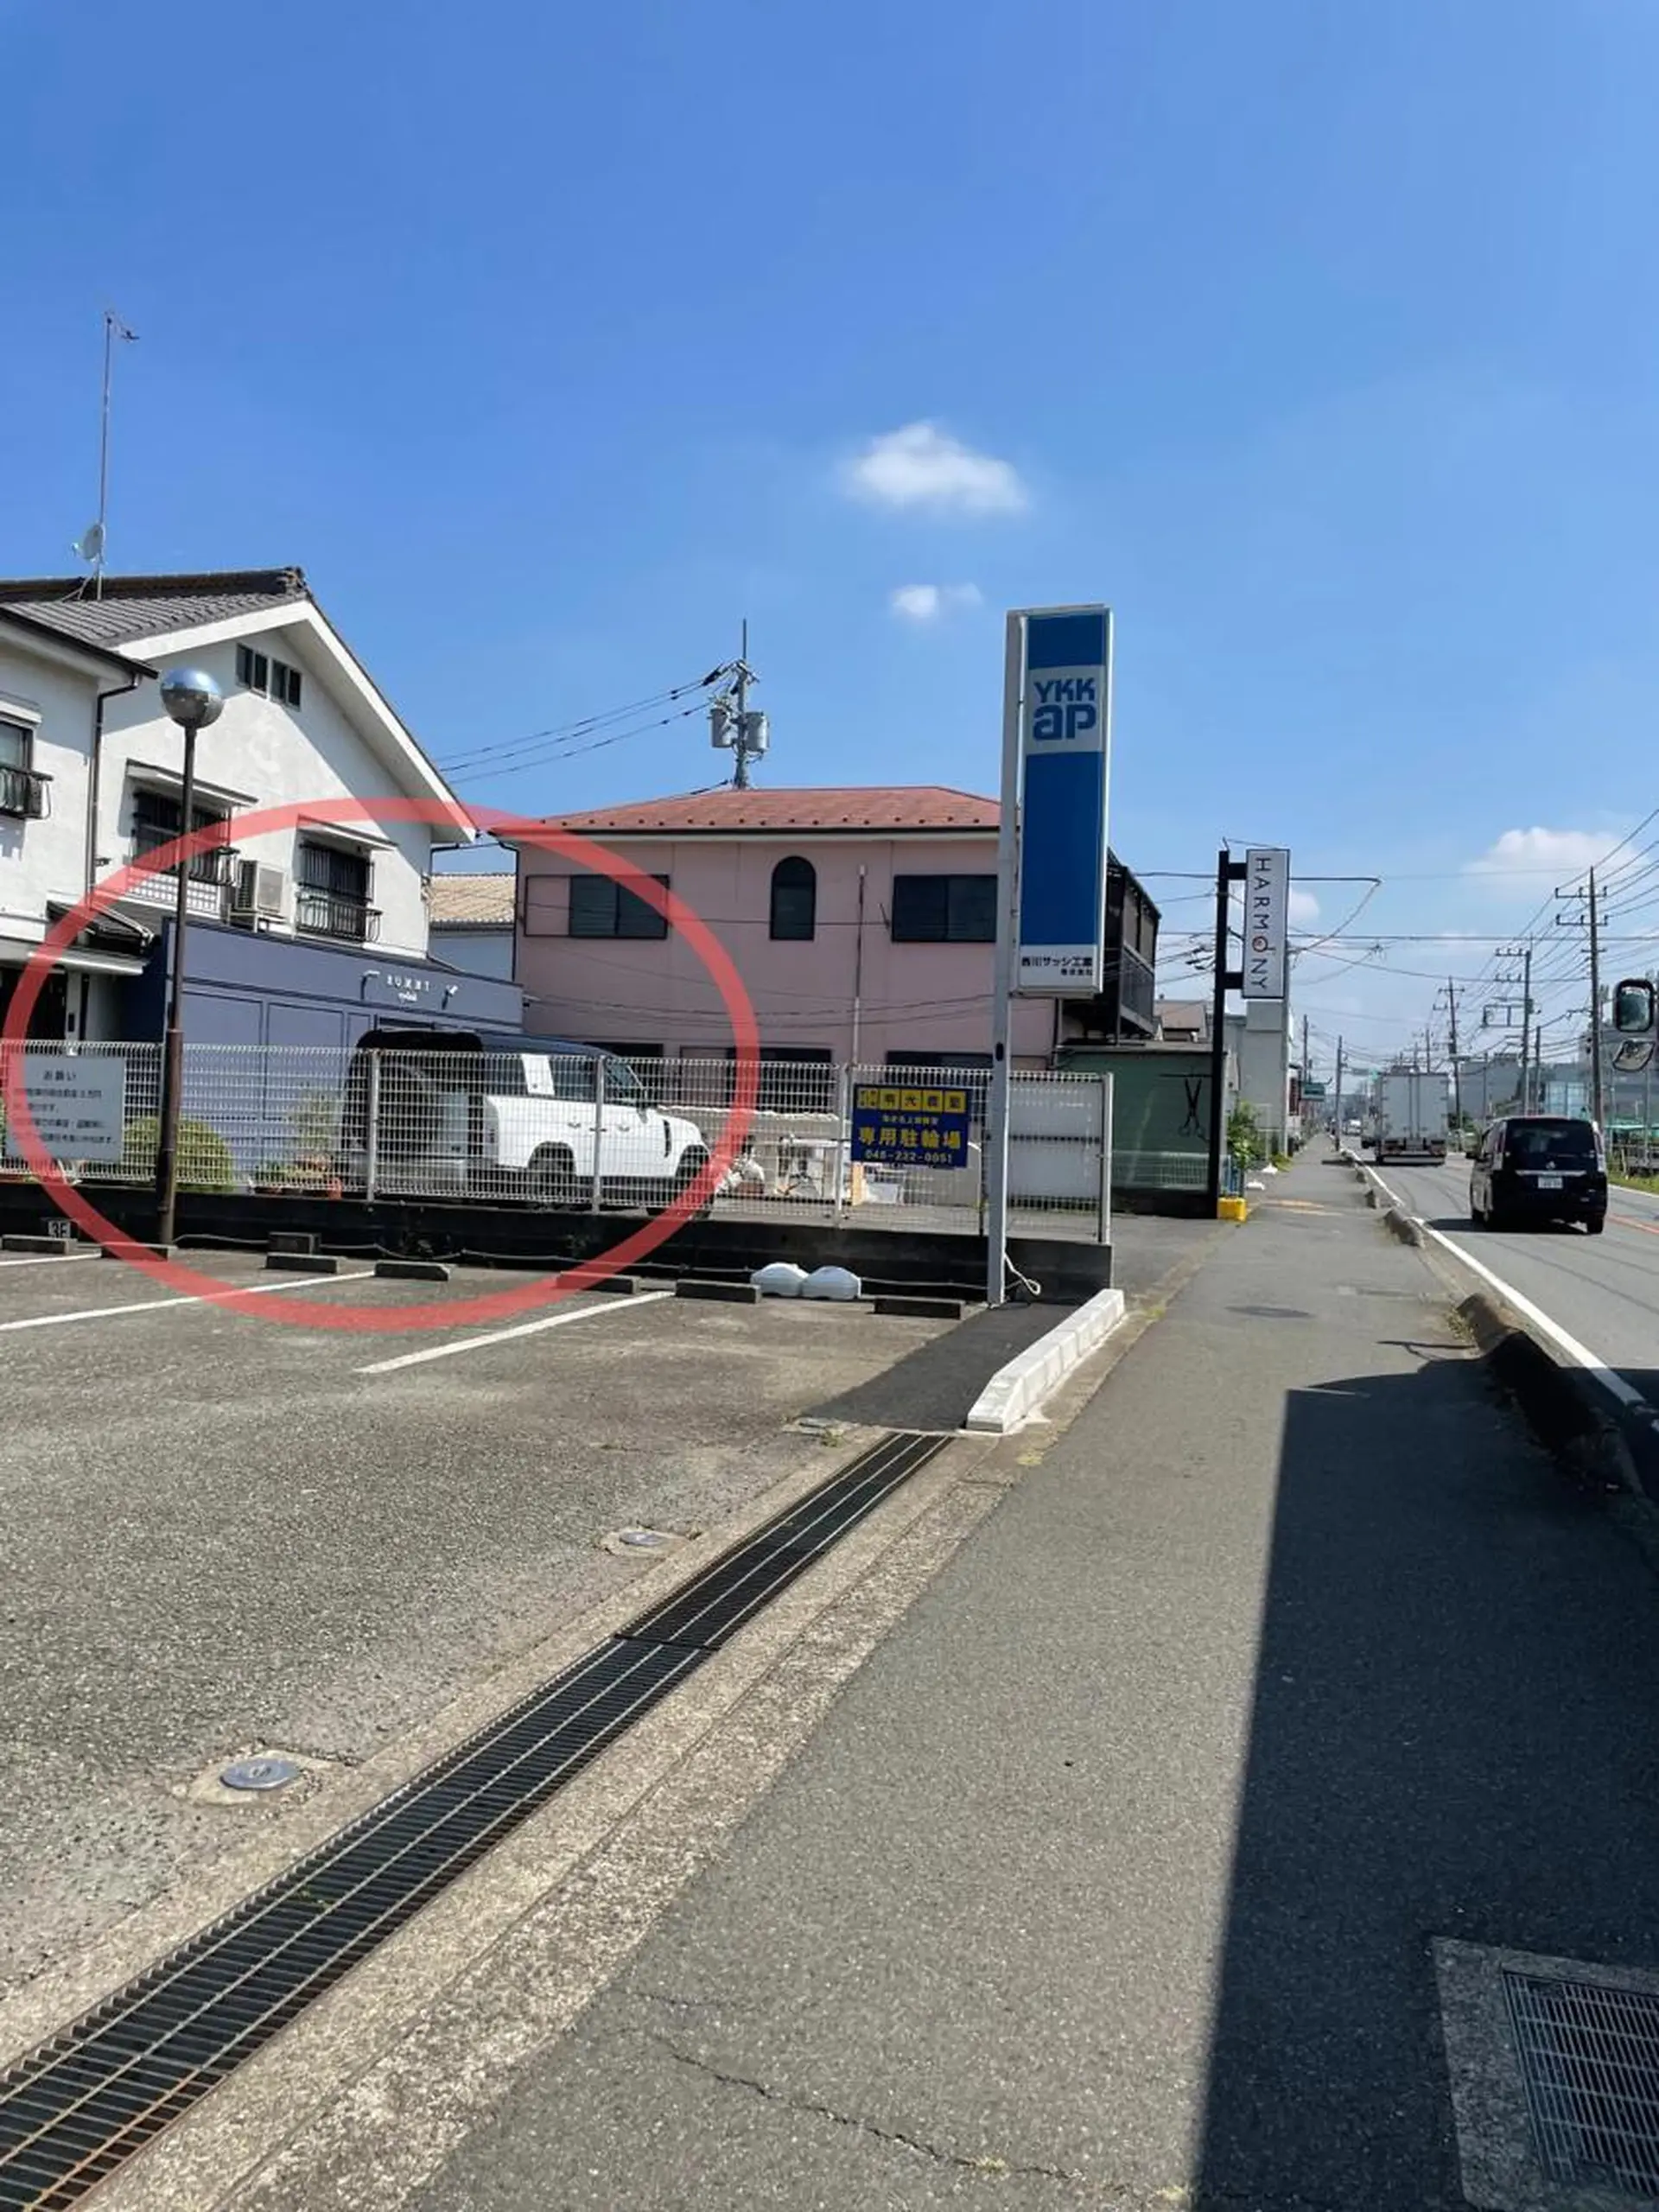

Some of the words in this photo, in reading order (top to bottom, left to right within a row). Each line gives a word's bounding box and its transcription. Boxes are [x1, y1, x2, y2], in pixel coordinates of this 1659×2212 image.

[1033, 677, 1096, 704] YKK
[1033, 705, 1096, 741] ap
[1250, 856, 1274, 992] HARMONY
